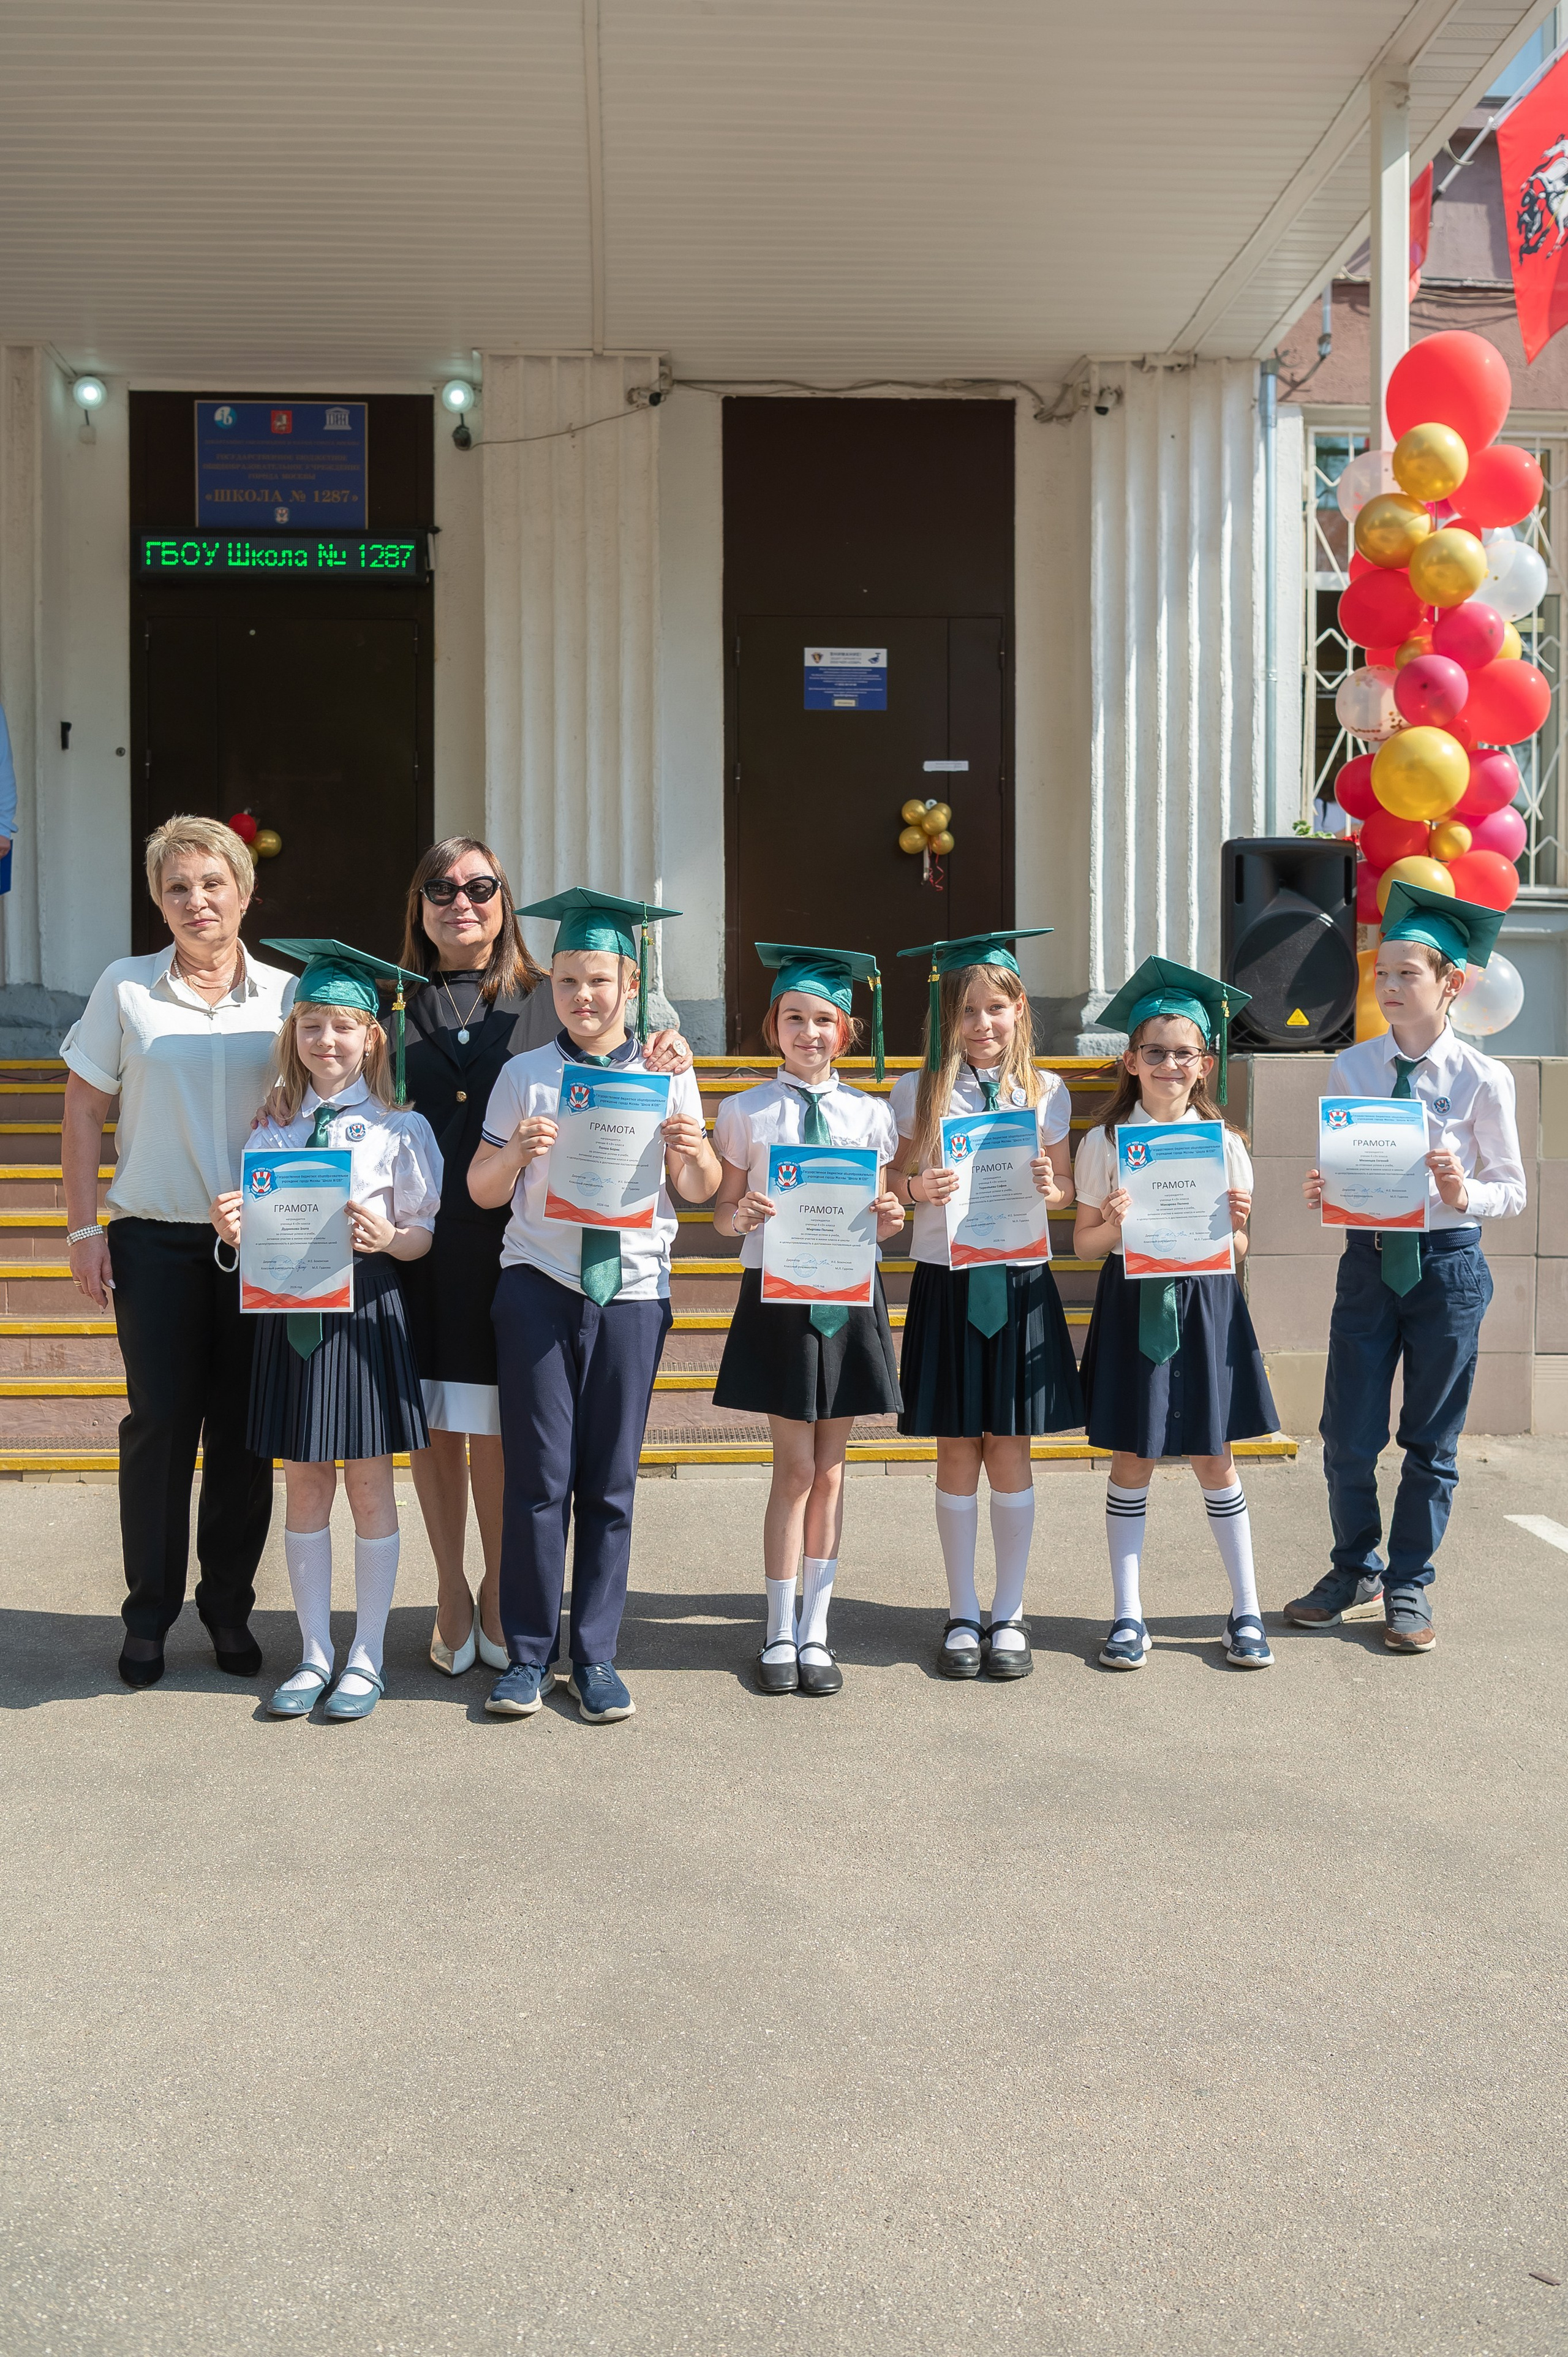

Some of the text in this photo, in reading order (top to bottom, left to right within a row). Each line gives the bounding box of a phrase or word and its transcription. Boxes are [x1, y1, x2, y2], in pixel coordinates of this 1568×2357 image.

[205, 489, 359, 503] «ШКОЛА № 1287»
[145, 541, 415, 569] ГБОУ Школа № 1287
[589, 1122, 635, 1135] ГРАМОТА
[971, 1162, 1013, 1173] ГРАМОТА
[1152, 1180, 1196, 1189] ГРАМОТА
[799, 1205, 844, 1214] ГРАМОТА
